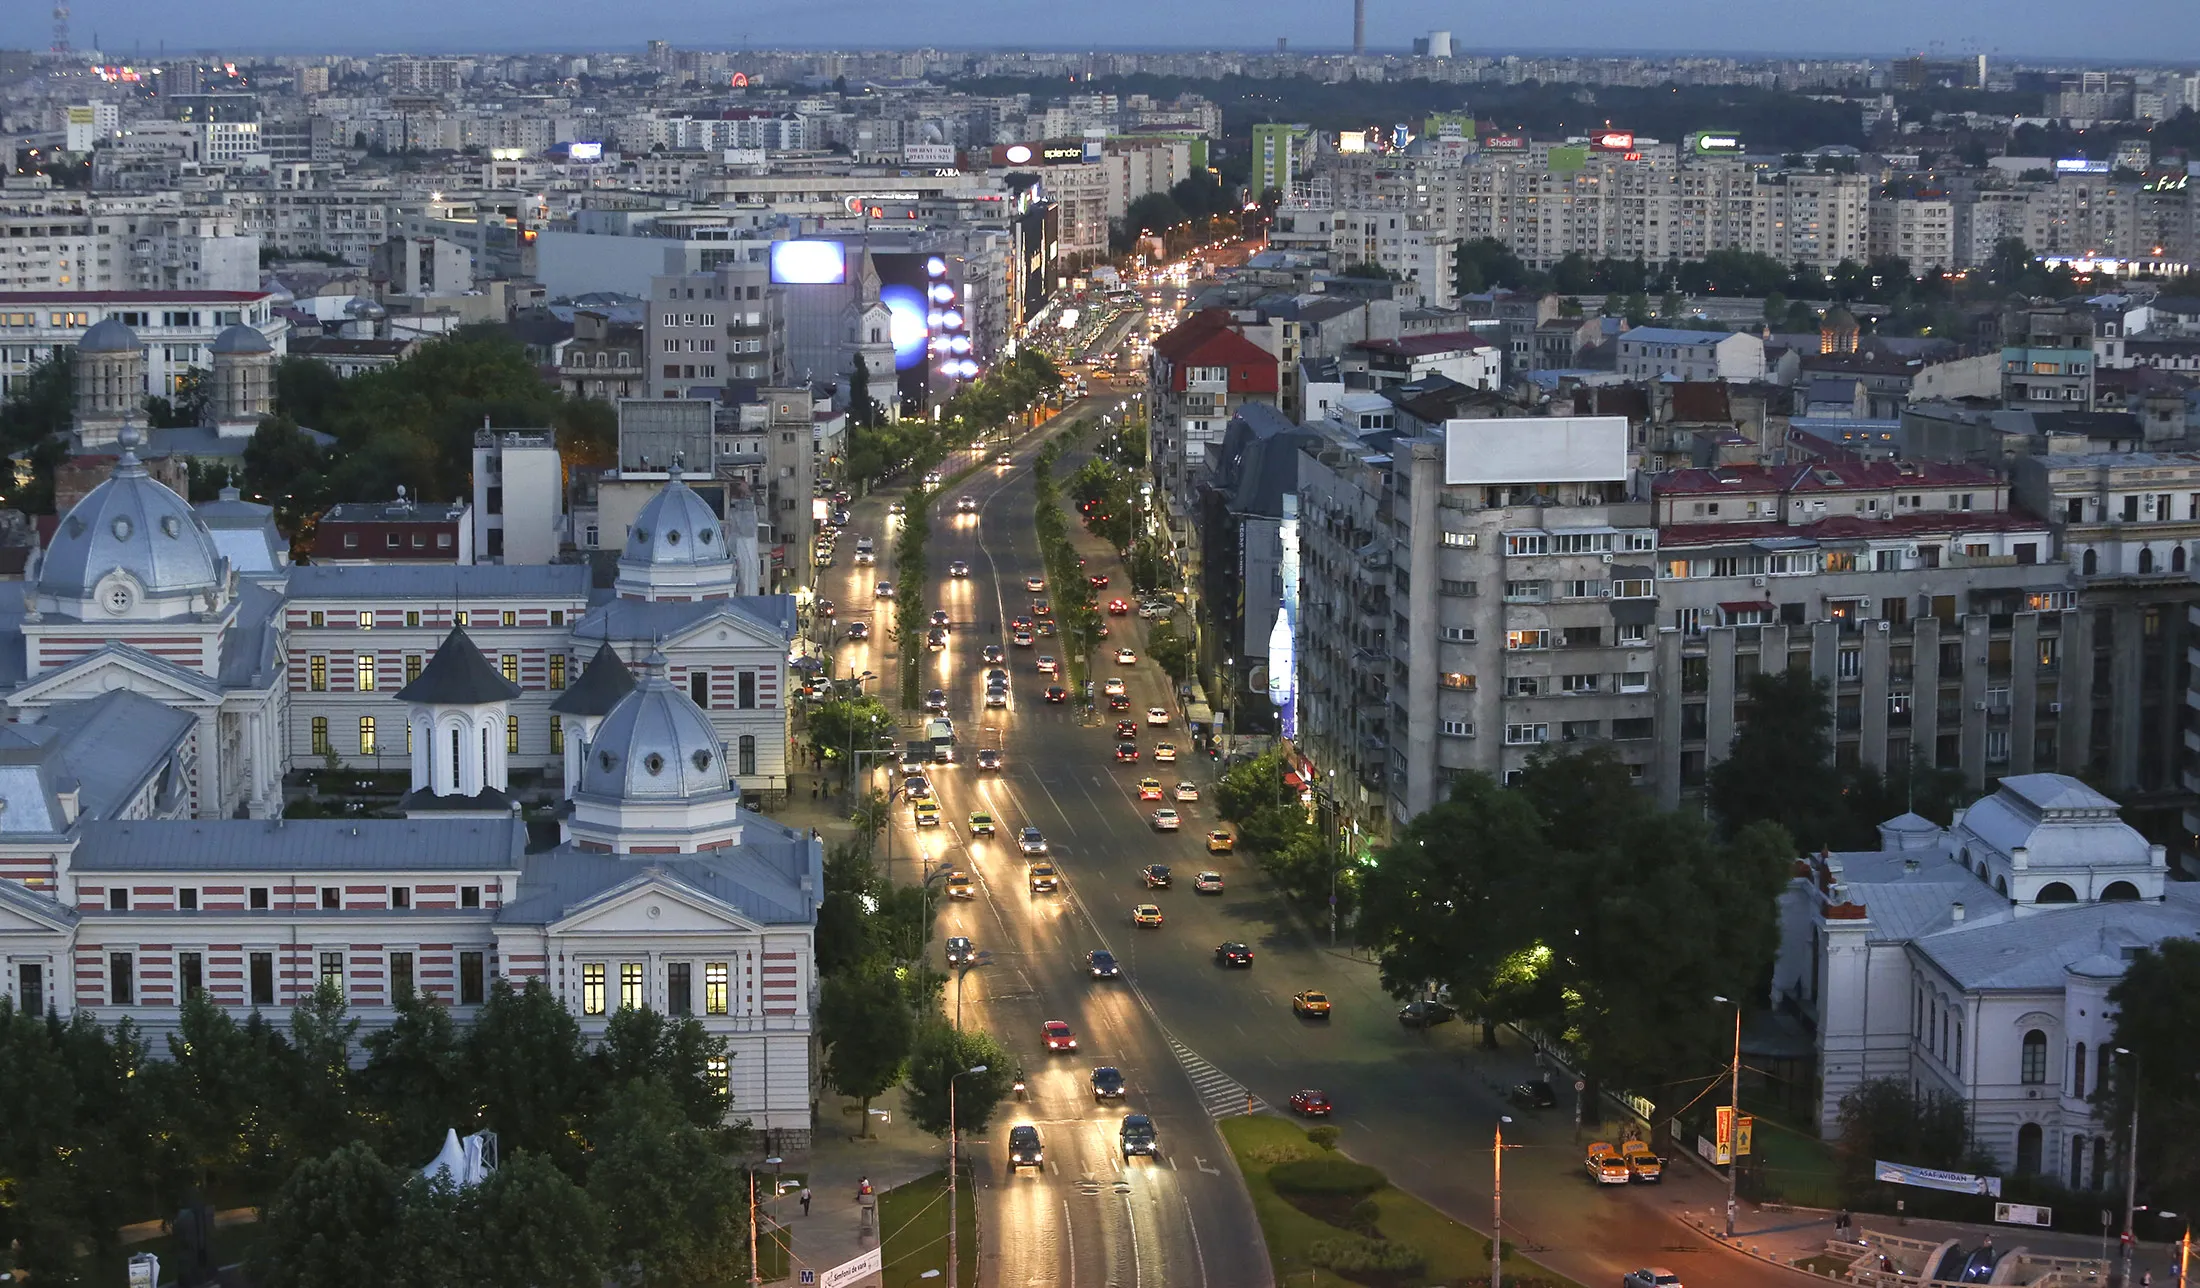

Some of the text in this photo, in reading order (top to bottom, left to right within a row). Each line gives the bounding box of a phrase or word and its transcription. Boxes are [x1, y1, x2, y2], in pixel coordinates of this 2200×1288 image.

[1044, 148, 1081, 159] splendor
[935, 168, 960, 177] ZARA
[1919, 1170, 1967, 1182] ASAF AVIDAN
[801, 1271, 814, 1283] M
